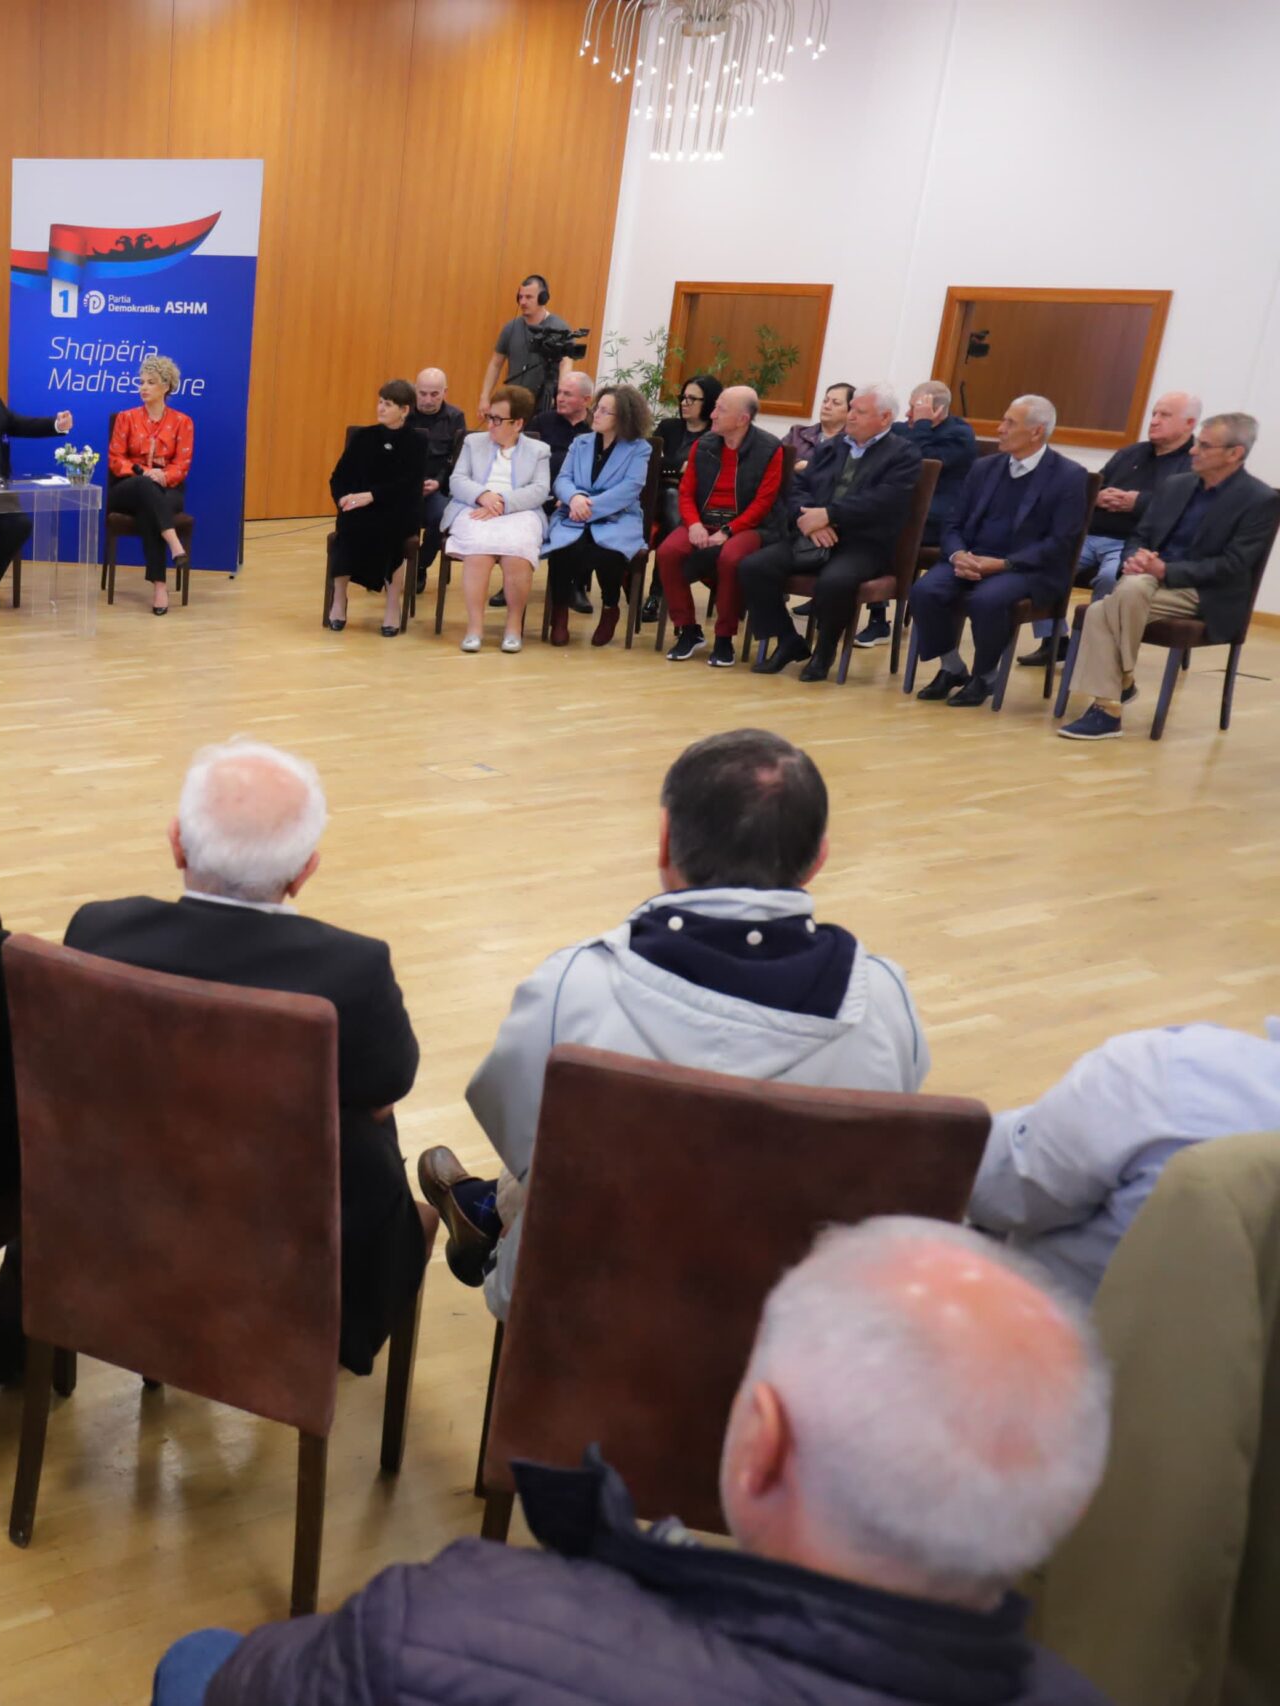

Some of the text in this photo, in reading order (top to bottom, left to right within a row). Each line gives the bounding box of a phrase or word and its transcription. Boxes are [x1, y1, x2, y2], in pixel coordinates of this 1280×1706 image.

[58, 289, 70, 313] 1
[108, 294, 131, 304] Partia
[108, 303, 161, 314] Demokratike
[164, 301, 208, 315] ASHM
[48, 336, 158, 366] Shqipëria
[48, 368, 205, 396] Madhësre
